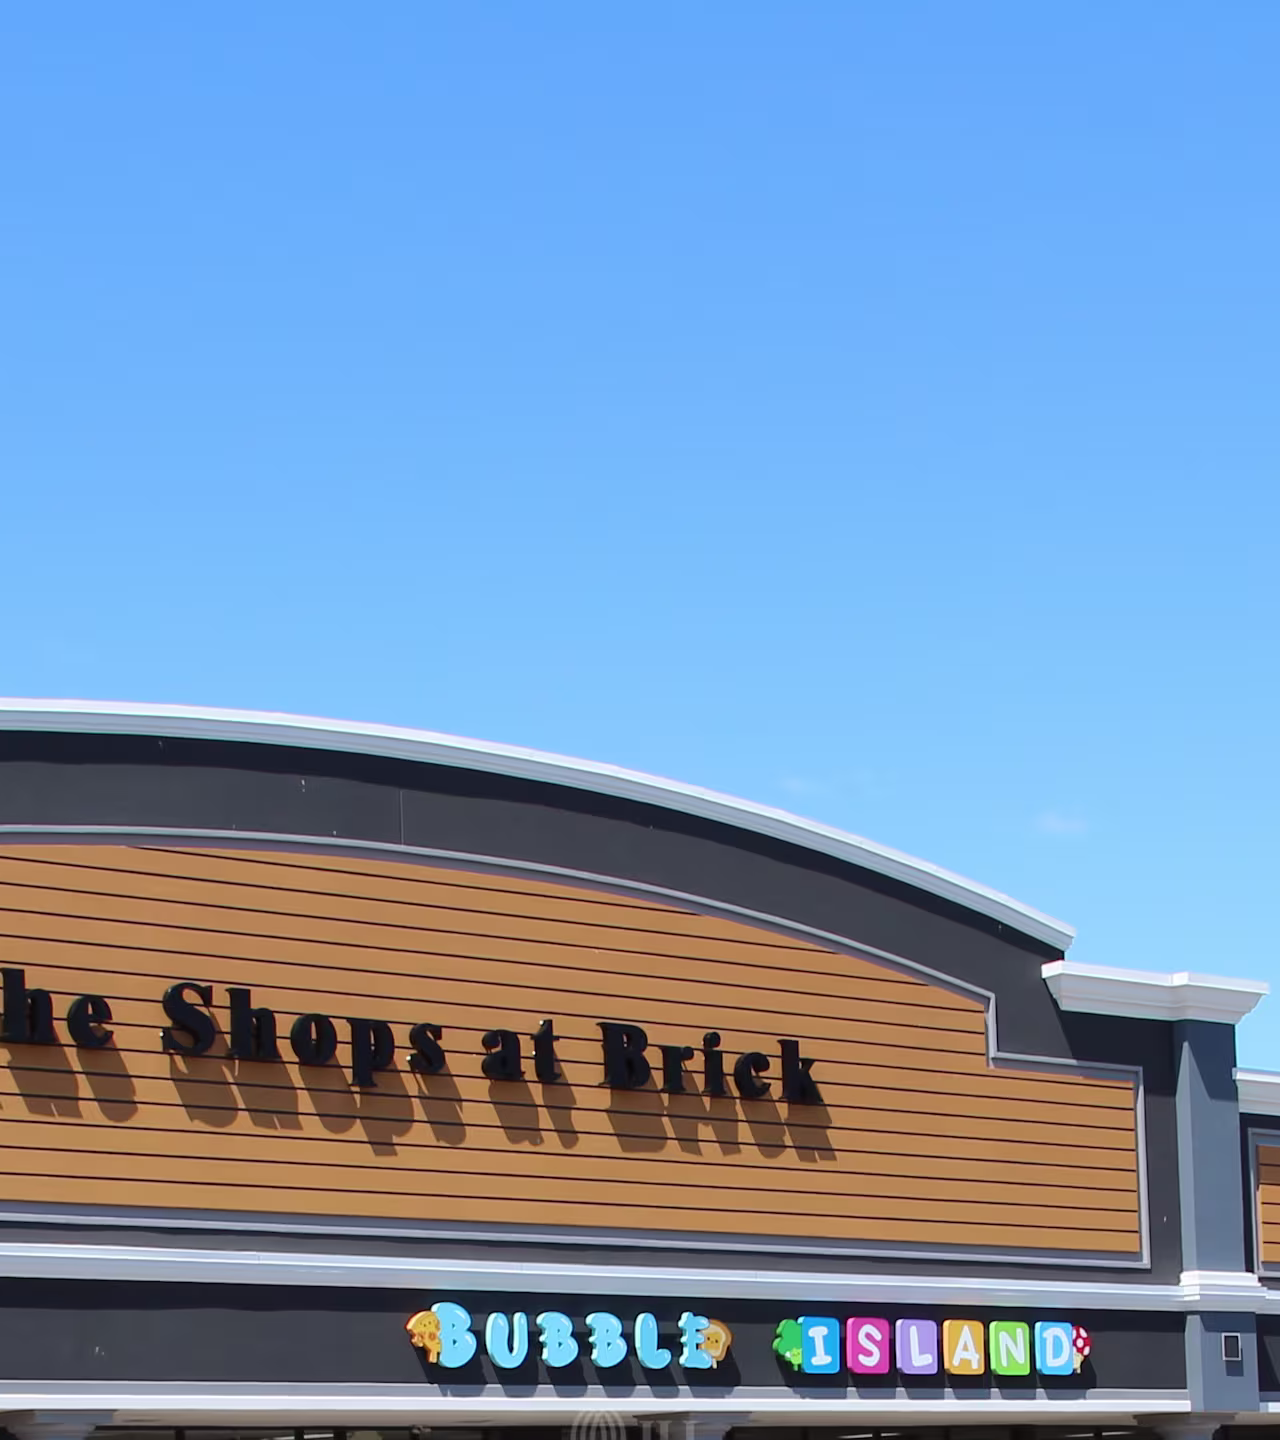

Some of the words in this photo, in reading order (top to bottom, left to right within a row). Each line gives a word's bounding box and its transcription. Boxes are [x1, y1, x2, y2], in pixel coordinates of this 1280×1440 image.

[161, 981, 446, 1087] Shops
[481, 1019, 561, 1081] at
[596, 1022, 824, 1105] Brick
[431, 1302, 713, 1369] BUBBLE
[808, 1323, 1070, 1370] ISLAND
